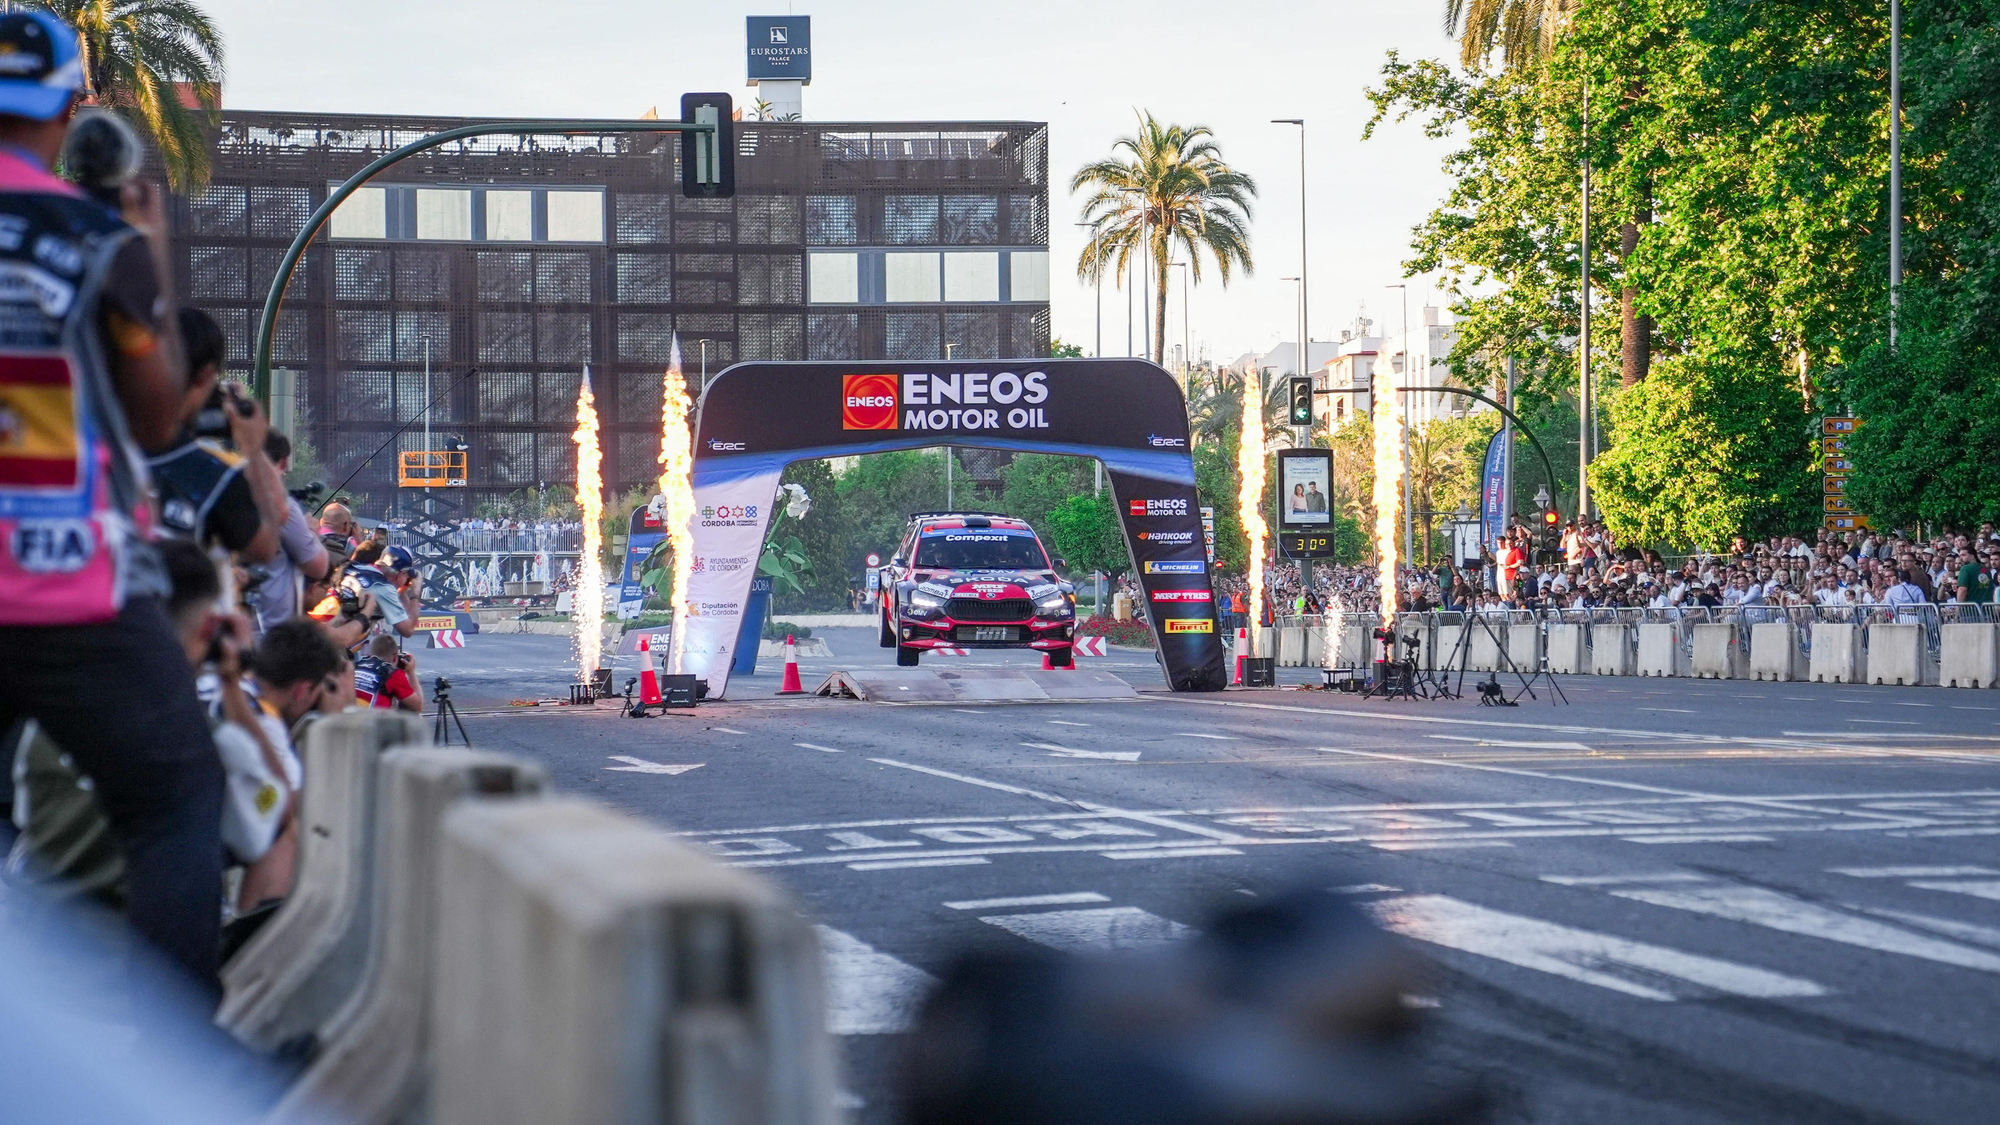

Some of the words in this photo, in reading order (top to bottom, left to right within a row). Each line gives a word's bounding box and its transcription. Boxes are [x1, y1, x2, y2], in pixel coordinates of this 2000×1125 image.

[750, 47, 808, 56] EUROSTARS
[903, 371, 1049, 404] ENEOS
[846, 396, 894, 407] ENEOS
[904, 408, 1000, 430] MOTOR
[1007, 408, 1049, 428] OIL
[713, 442, 746, 450] ERC
[1153, 438, 1184, 446] ERC
[445, 478, 466, 486] JCB
[1146, 499, 1187, 509] ENEOS
[18, 529, 88, 561] FIA
[751, 580, 769, 591] DOBA
[416, 618, 452, 628] PIRELLI
[1170, 622, 1209, 630] PIRELLI
[650, 634, 670, 644] ENE
